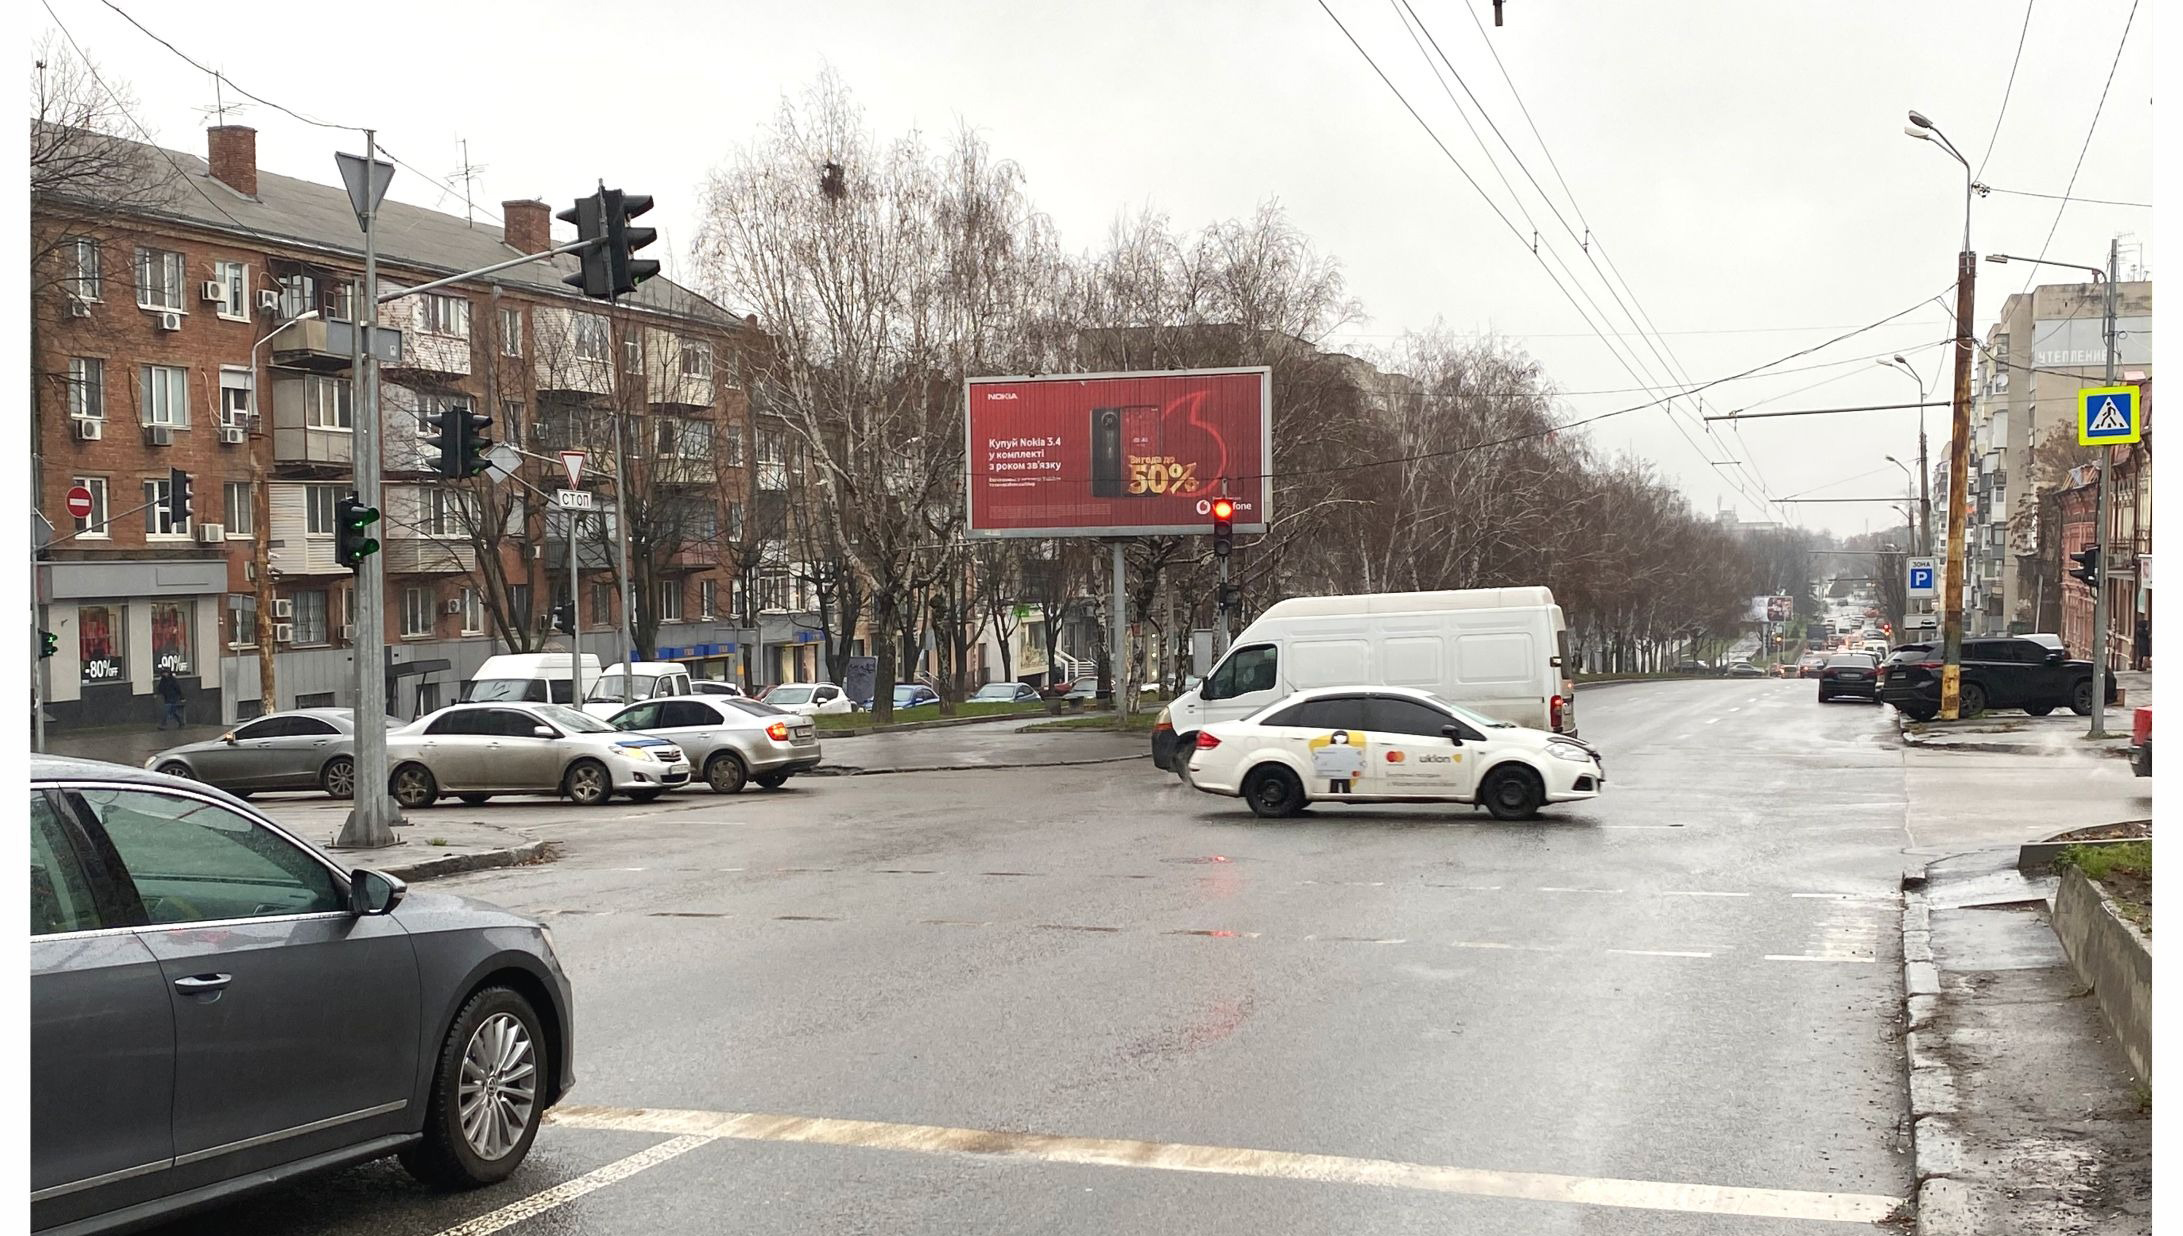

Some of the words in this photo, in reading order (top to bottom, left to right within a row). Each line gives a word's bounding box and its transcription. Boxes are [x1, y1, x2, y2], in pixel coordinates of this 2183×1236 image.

[2037, 349, 2108, 363] УТЕПЛЕНИЕ
[989, 438, 1018, 449] Купуй
[1020, 438, 1046, 447] Nokia
[1047, 436, 1061, 446] 3.4
[996, 449, 1045, 459] комплекті
[996, 462, 1026, 472] роком
[1128, 462, 1198, 494] 50%
[562, 493, 589, 507] СТОП
[1915, 571, 1928, 586] P
